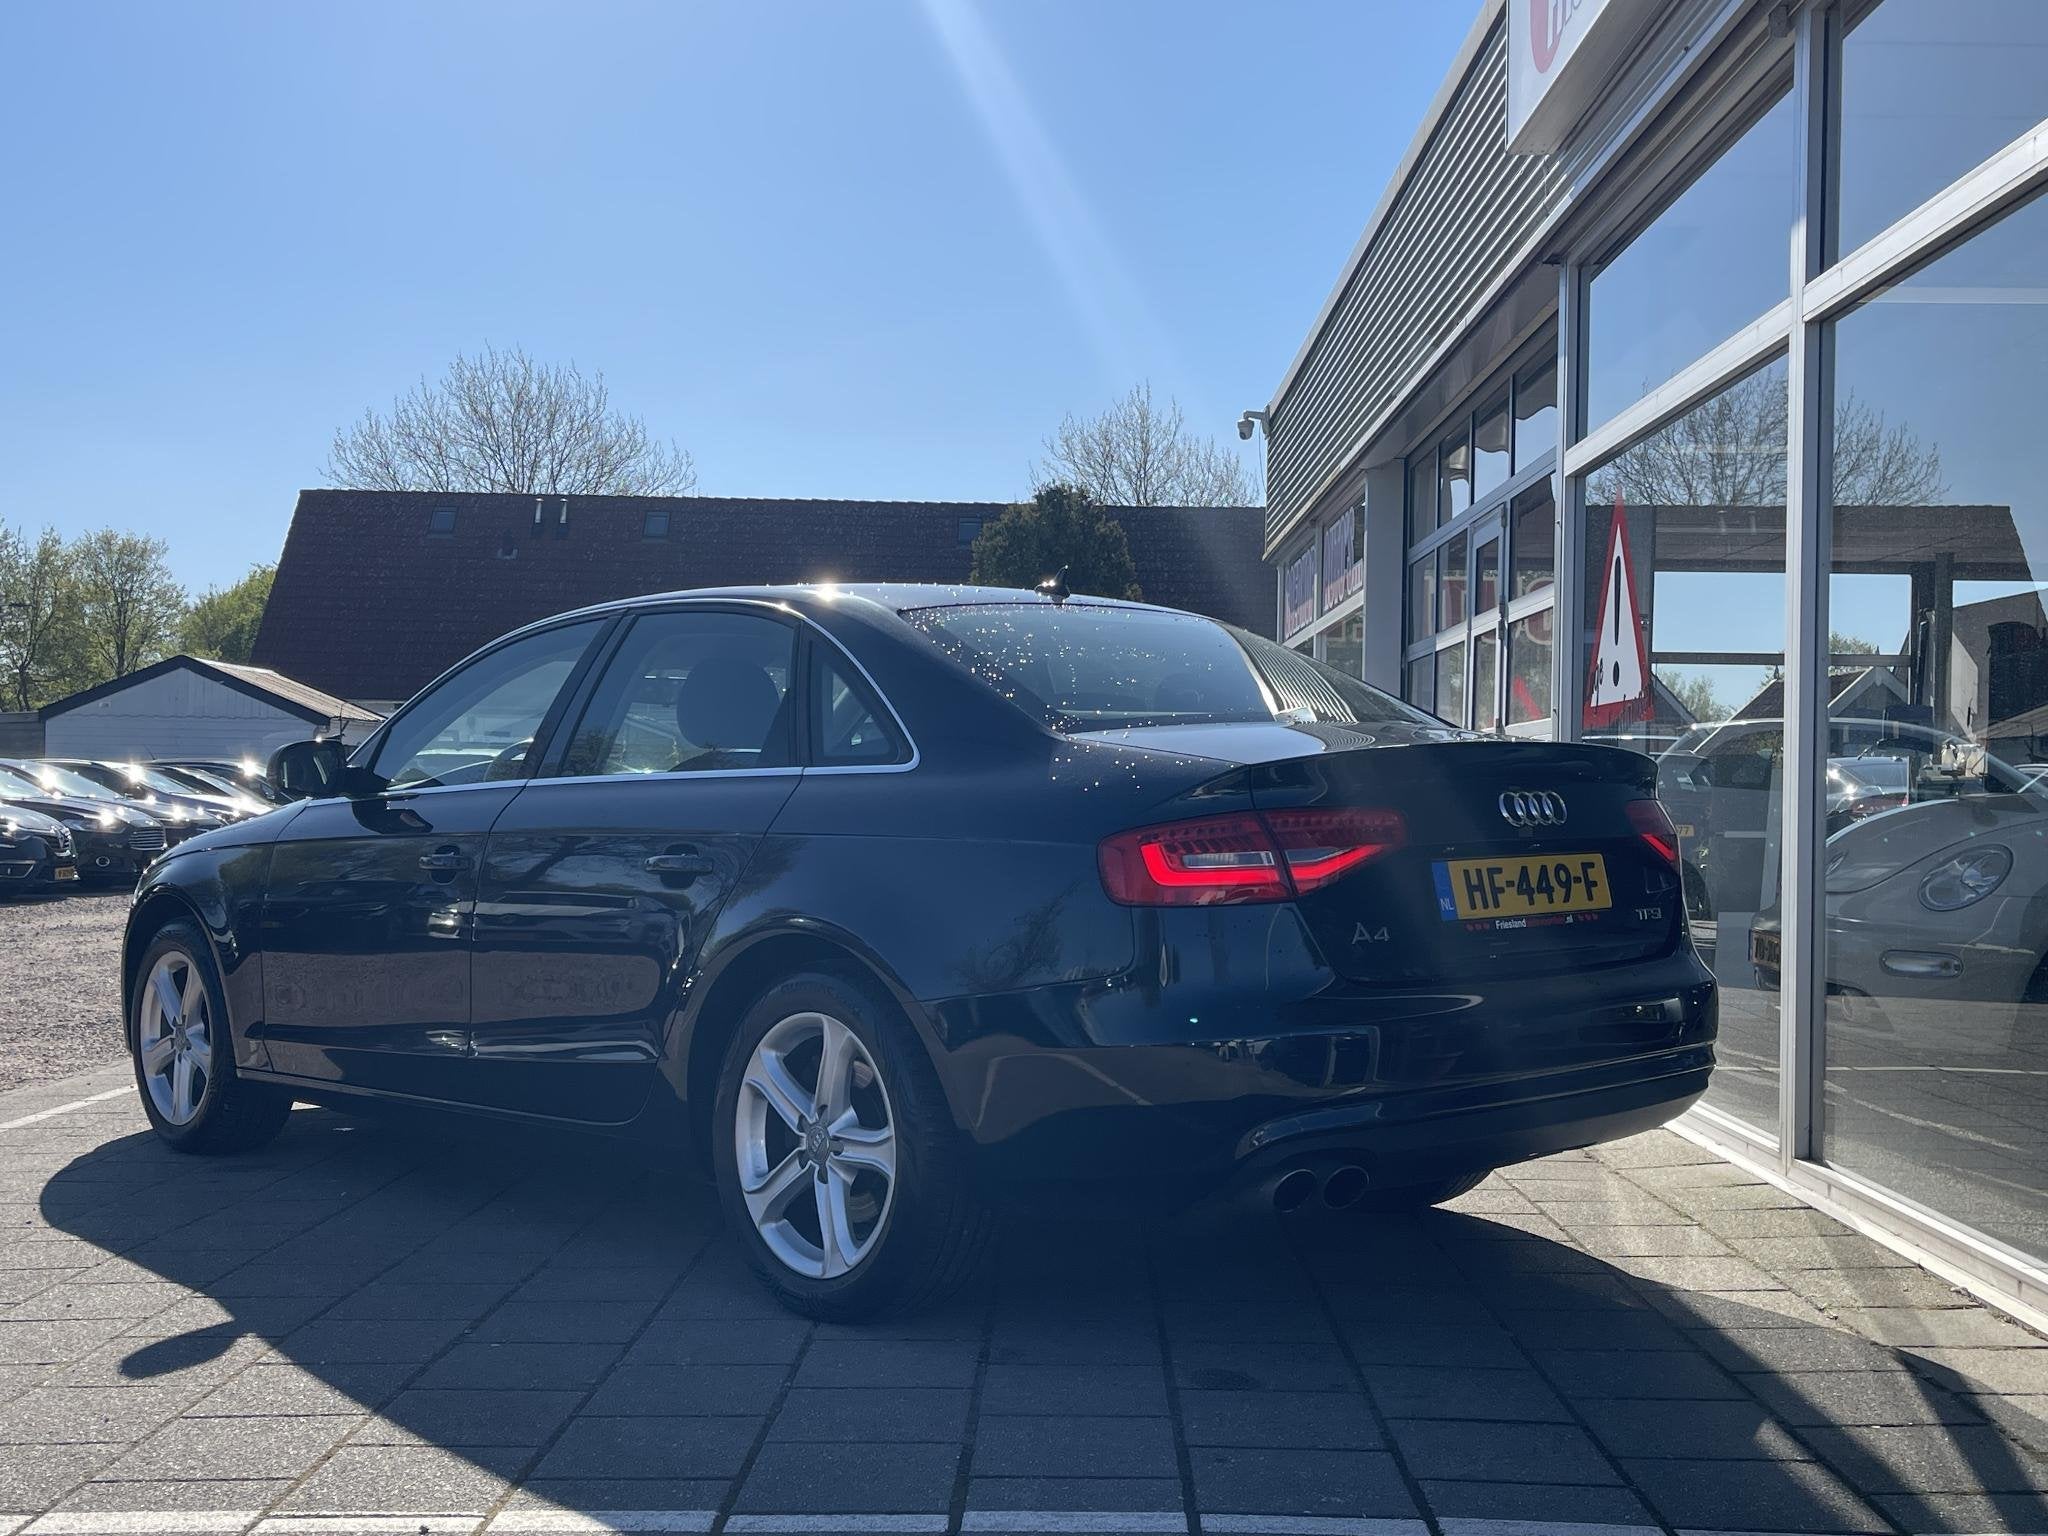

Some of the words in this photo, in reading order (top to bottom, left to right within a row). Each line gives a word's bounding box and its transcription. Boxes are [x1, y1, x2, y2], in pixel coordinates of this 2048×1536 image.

[1463, 862, 1599, 909] HF-449-F
[1440, 897, 1455, 912] NL
[1351, 921, 1390, 945] A4
